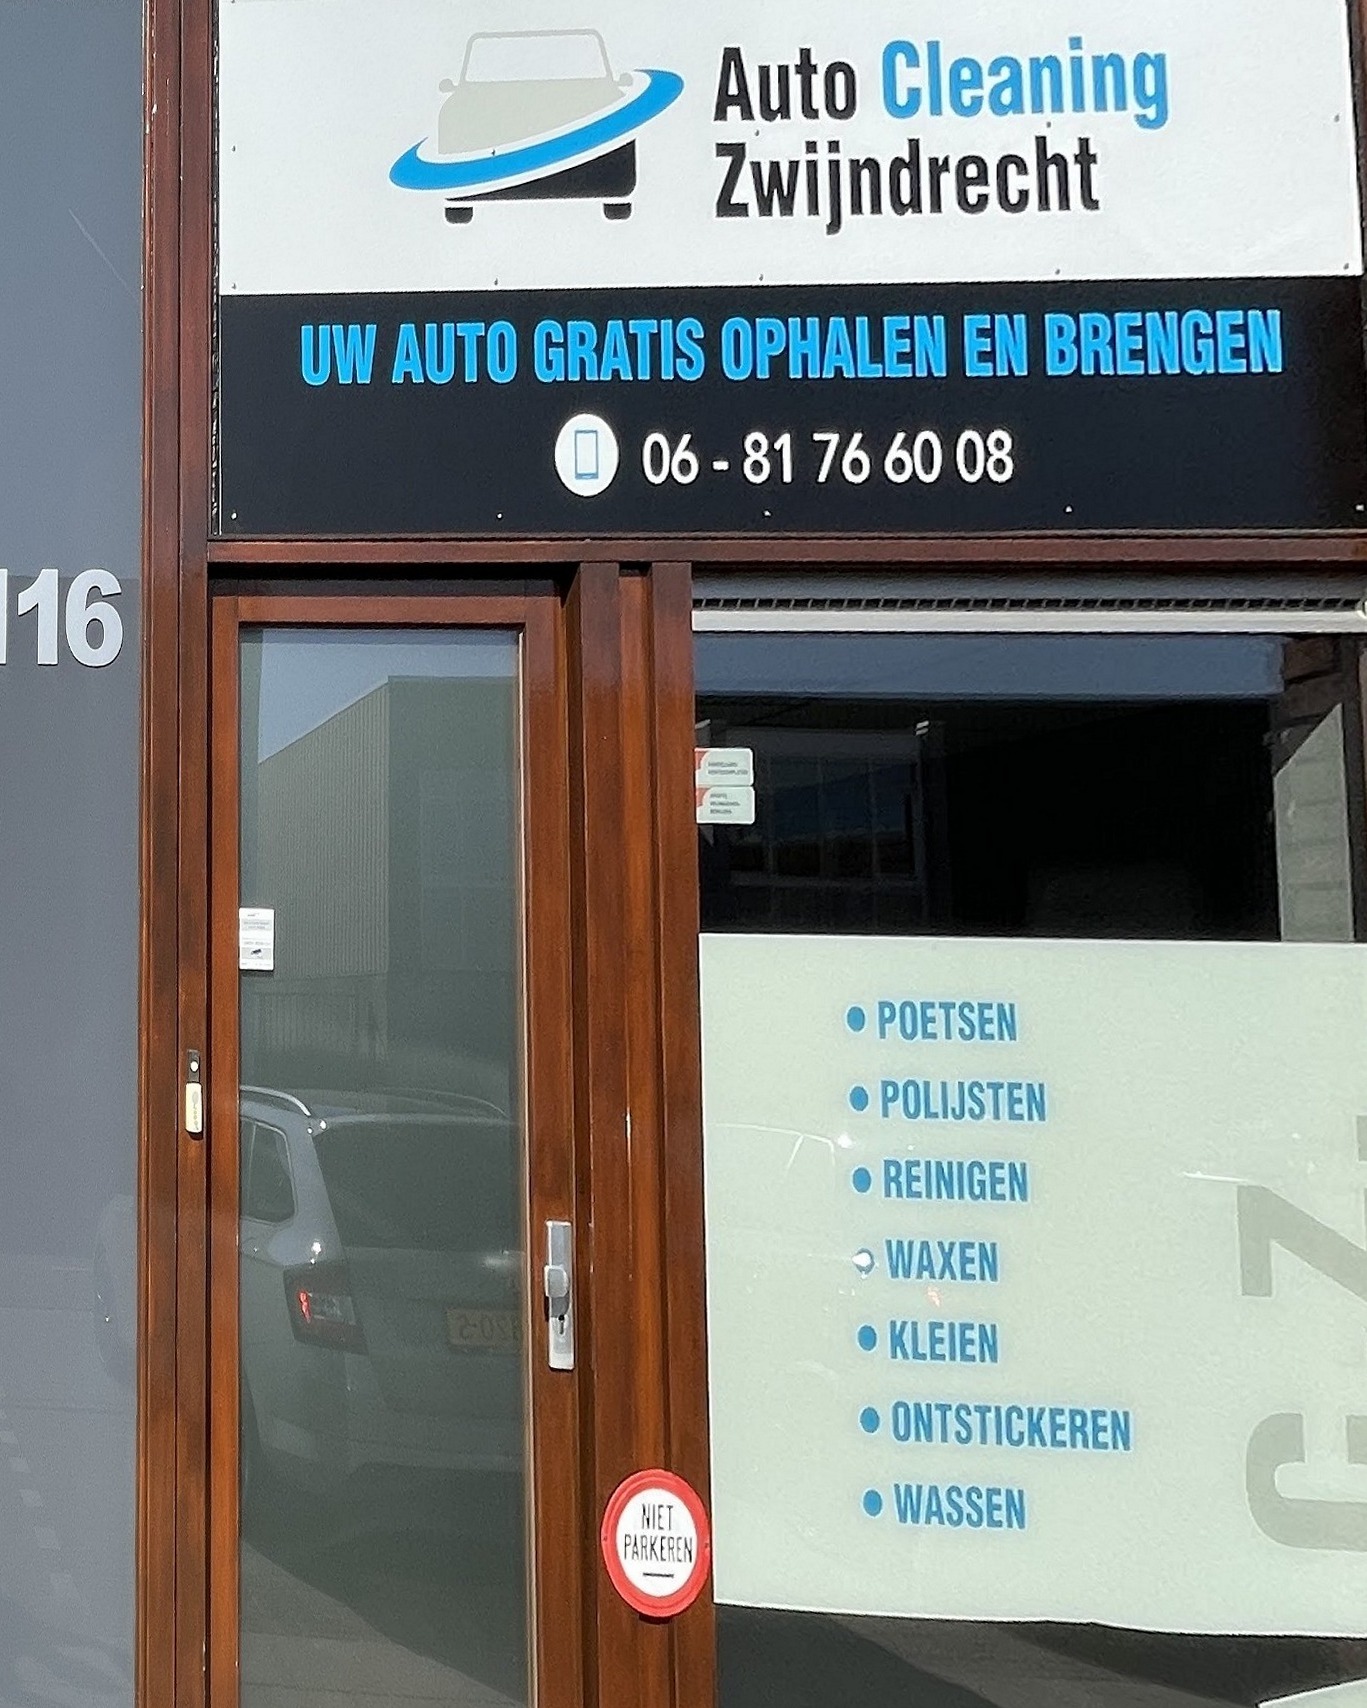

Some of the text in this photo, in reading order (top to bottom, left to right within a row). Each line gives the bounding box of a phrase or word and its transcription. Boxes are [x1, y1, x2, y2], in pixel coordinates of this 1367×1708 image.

[713, 36, 1169, 129] Auto Cleaning
[713, 136, 1101, 236] Zwijndrecht
[301, 309, 1284, 386] UW AUTO GRATIS OPHALEN EN BRENGEN
[642, 431, 700, 486] 06
[742, 431, 793, 485] 81
[812, 431, 871, 484] 76
[883, 430, 943, 484] 60
[955, 430, 1015, 484] 08
[0, 568, 124, 668] 16
[877, 1000, 1018, 1042] POETSEN
[880, 1079, 1047, 1122] POLIJSTEN
[883, 1158, 1029, 1202] REINIGEN
[884, 1239, 999, 1283] WAXEN
[889, 1319, 999, 1364] KLEIEN
[891, 1401, 1132, 1452] ONTSTICKEREN
[641, 1503, 674, 1531] NIET
[893, 1483, 1026, 1530] WASSEN
[624, 1533, 693, 1563] PARKEREN
